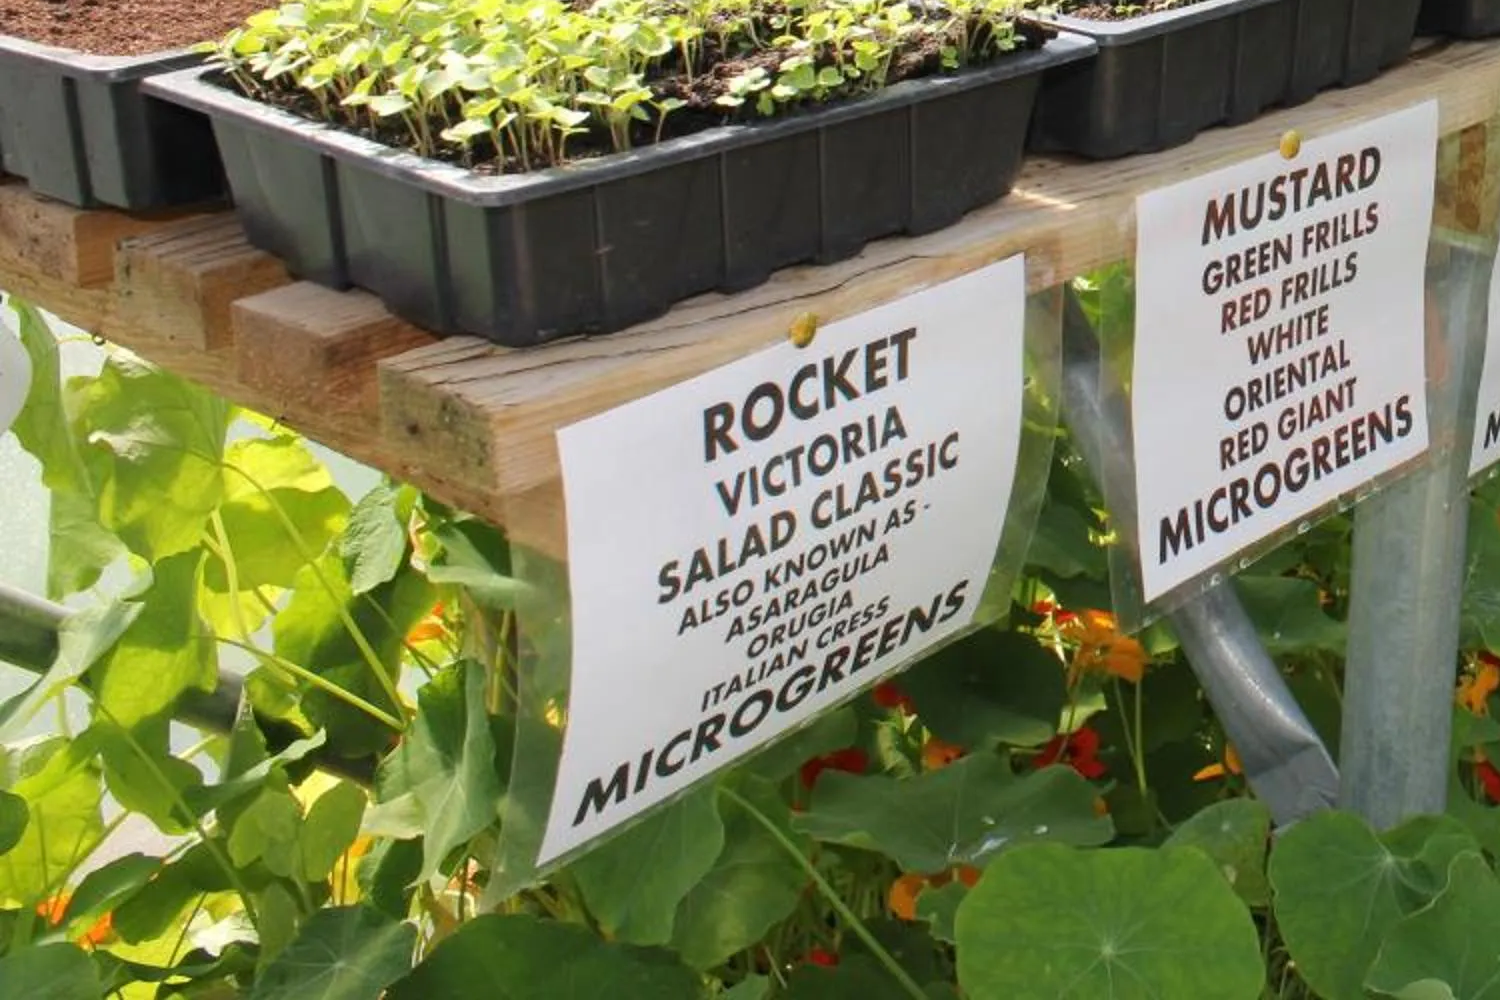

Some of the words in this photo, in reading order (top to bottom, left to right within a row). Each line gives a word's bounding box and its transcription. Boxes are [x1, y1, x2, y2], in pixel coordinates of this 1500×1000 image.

[1202, 145, 1382, 246] MUSTARD
[1202, 232, 1293, 297] GREEN
[1302, 202, 1380, 259] FRILLS
[1220, 288, 1272, 335] RED
[1280, 251, 1358, 311] FRILLS
[1224, 339, 1352, 422] ORIENTAL
[1247, 304, 1329, 366] WHITE
[703, 327, 917, 463] ROCKET
[1220, 425, 1269, 471] RED
[1277, 377, 1358, 441] GIANT
[716, 405, 908, 518] VICTORIA
[1159, 395, 1413, 565] MICROGREENS
[657, 509, 797, 605] SALAD
[809, 432, 960, 531] CLASSIC
[677, 579, 755, 636] ALSO
[763, 519, 876, 594] KNOWN
[746, 590, 854, 659] ORUGIA
[571, 579, 970, 828] MICROGREENS
[701, 639, 808, 712] ITALIAN
[815, 596, 891, 649] CRESS
